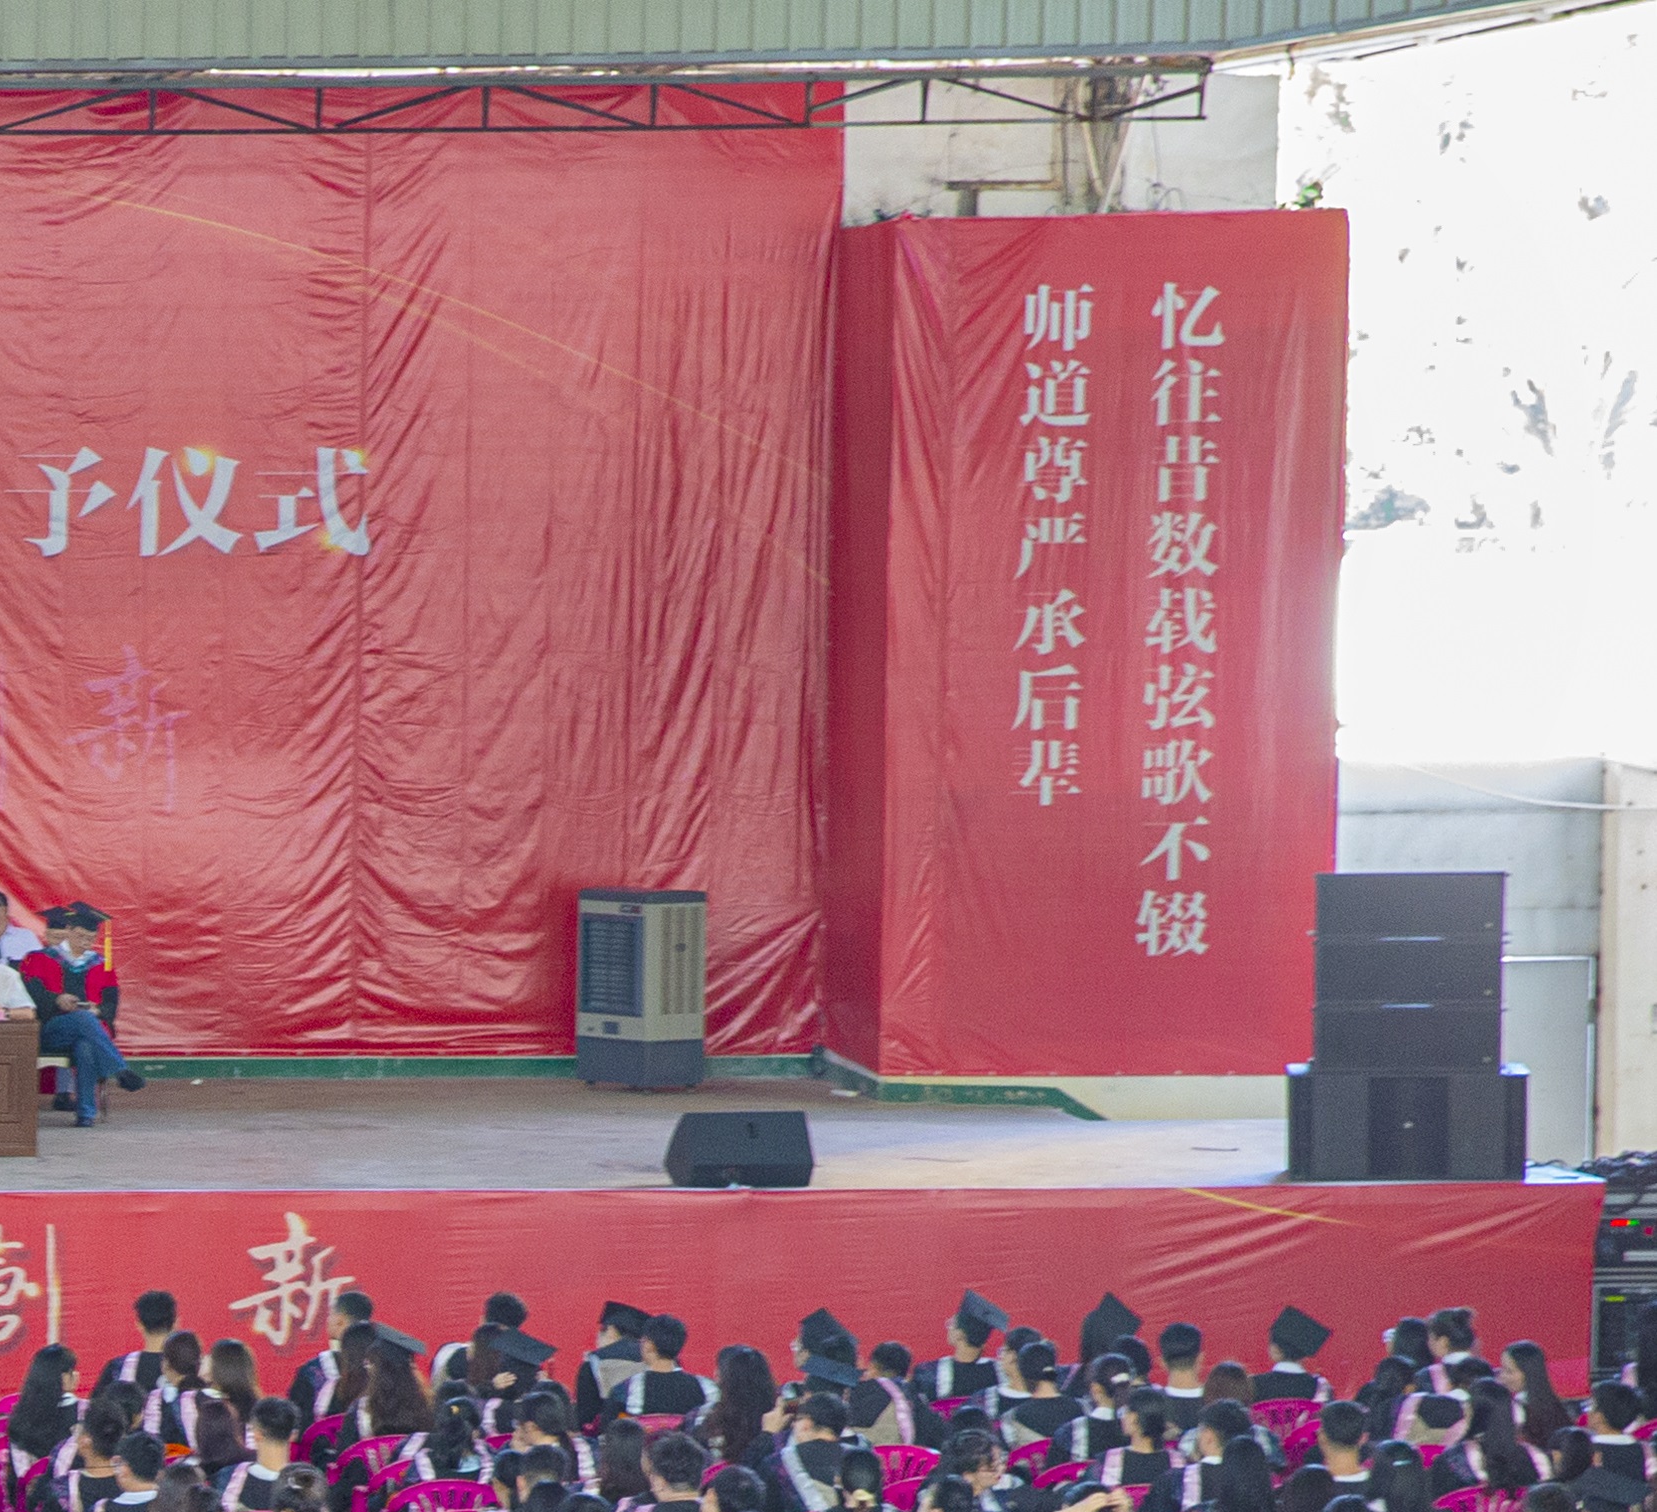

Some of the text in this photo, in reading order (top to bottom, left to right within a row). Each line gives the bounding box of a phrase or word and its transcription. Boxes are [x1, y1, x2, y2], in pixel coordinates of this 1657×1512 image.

[1012, 283, 1094, 806] 师道尊严承后辈
[1136, 282, 1225, 957] 忆往昔数载弦歌不辍
